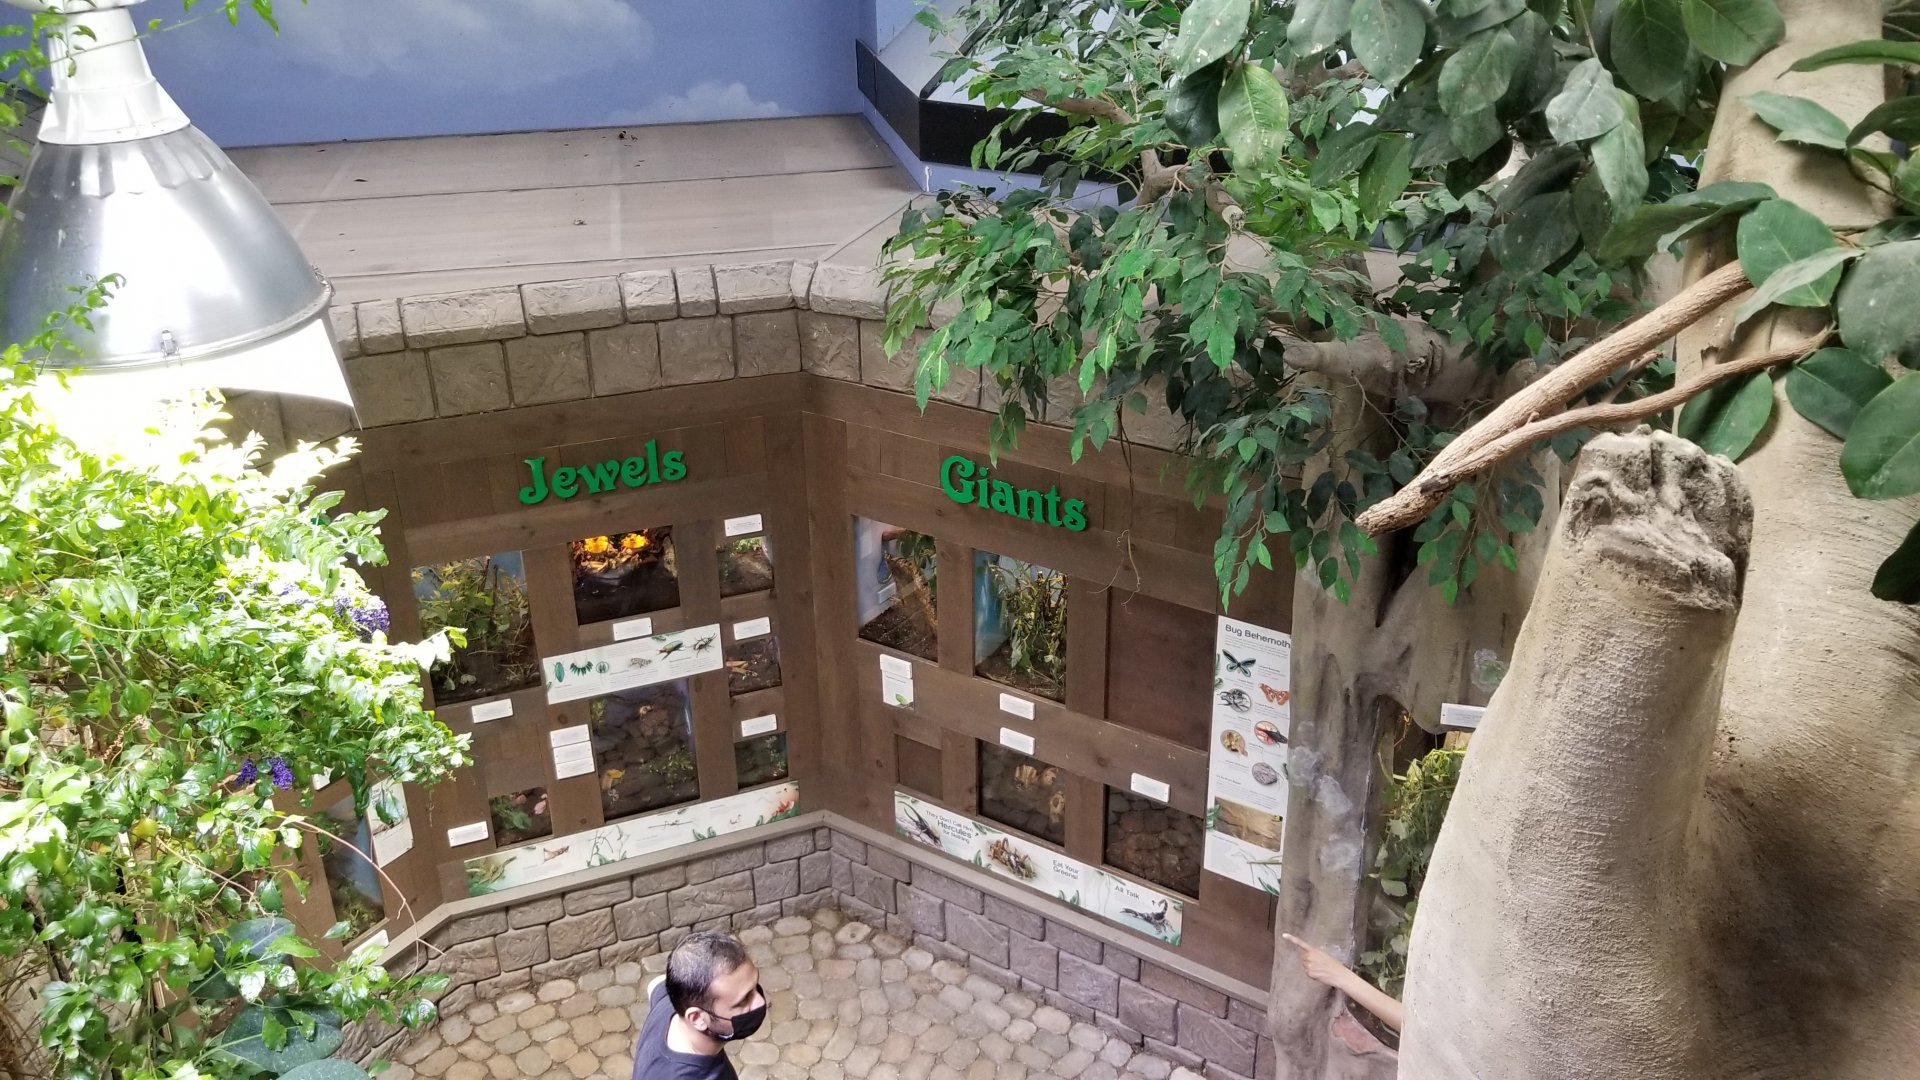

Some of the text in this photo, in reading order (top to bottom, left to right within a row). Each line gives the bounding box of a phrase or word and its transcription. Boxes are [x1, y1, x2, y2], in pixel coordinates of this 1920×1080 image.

[518, 439, 687, 505] Jewels
[940, 455, 1087, 532] Giants
[1225, 624, 1242, 637] Bug
[937, 819, 972, 838] Hercules
[1052, 859, 1079, 874] Eat Your
[1126, 889, 1140, 899] Talk
